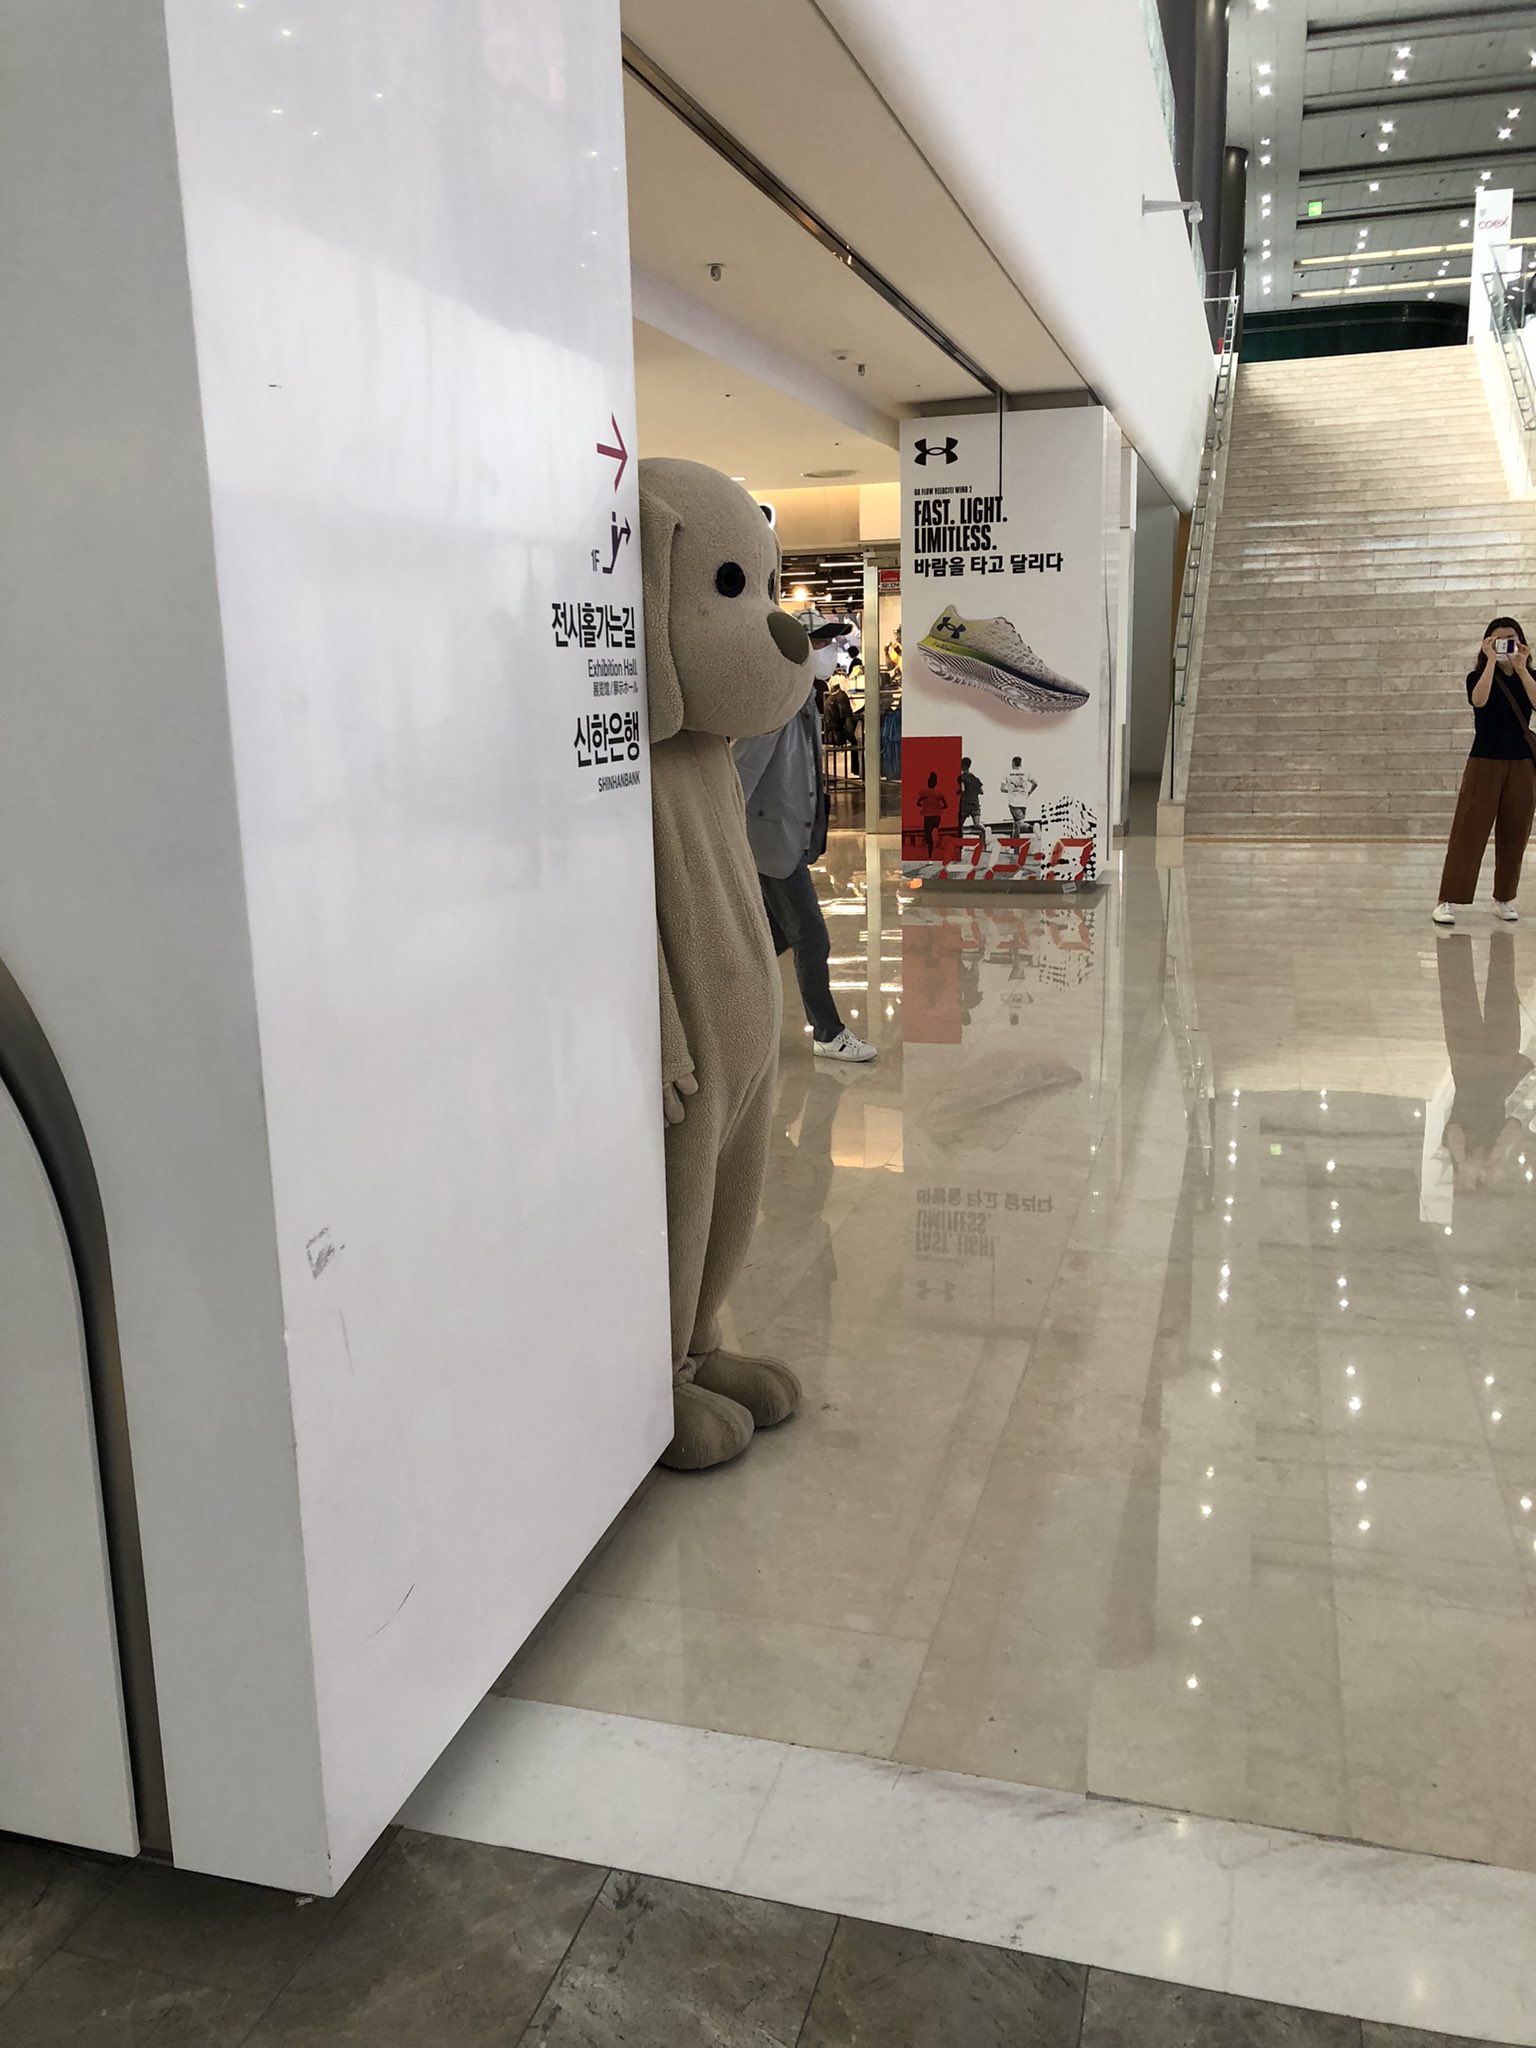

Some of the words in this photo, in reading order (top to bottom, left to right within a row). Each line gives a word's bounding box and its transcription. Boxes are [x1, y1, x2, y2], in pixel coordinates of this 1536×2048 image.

[914, 499, 955, 526] FAST.
[960, 496, 1008, 524] LIGHT.
[914, 524, 997, 554] LIMITLESS.
[914, 556, 965, 578] 바람을
[970, 555, 1005, 575] 타고
[1010, 552, 1063, 574] 달리다
[551, 602, 636, 649] 전시홀가는길
[588, 658, 623, 677] Exhibition
[623, 658, 638, 676] Hall
[573, 711, 640, 768] 신한은행
[598, 770, 641, 792] SHINHANBANK
